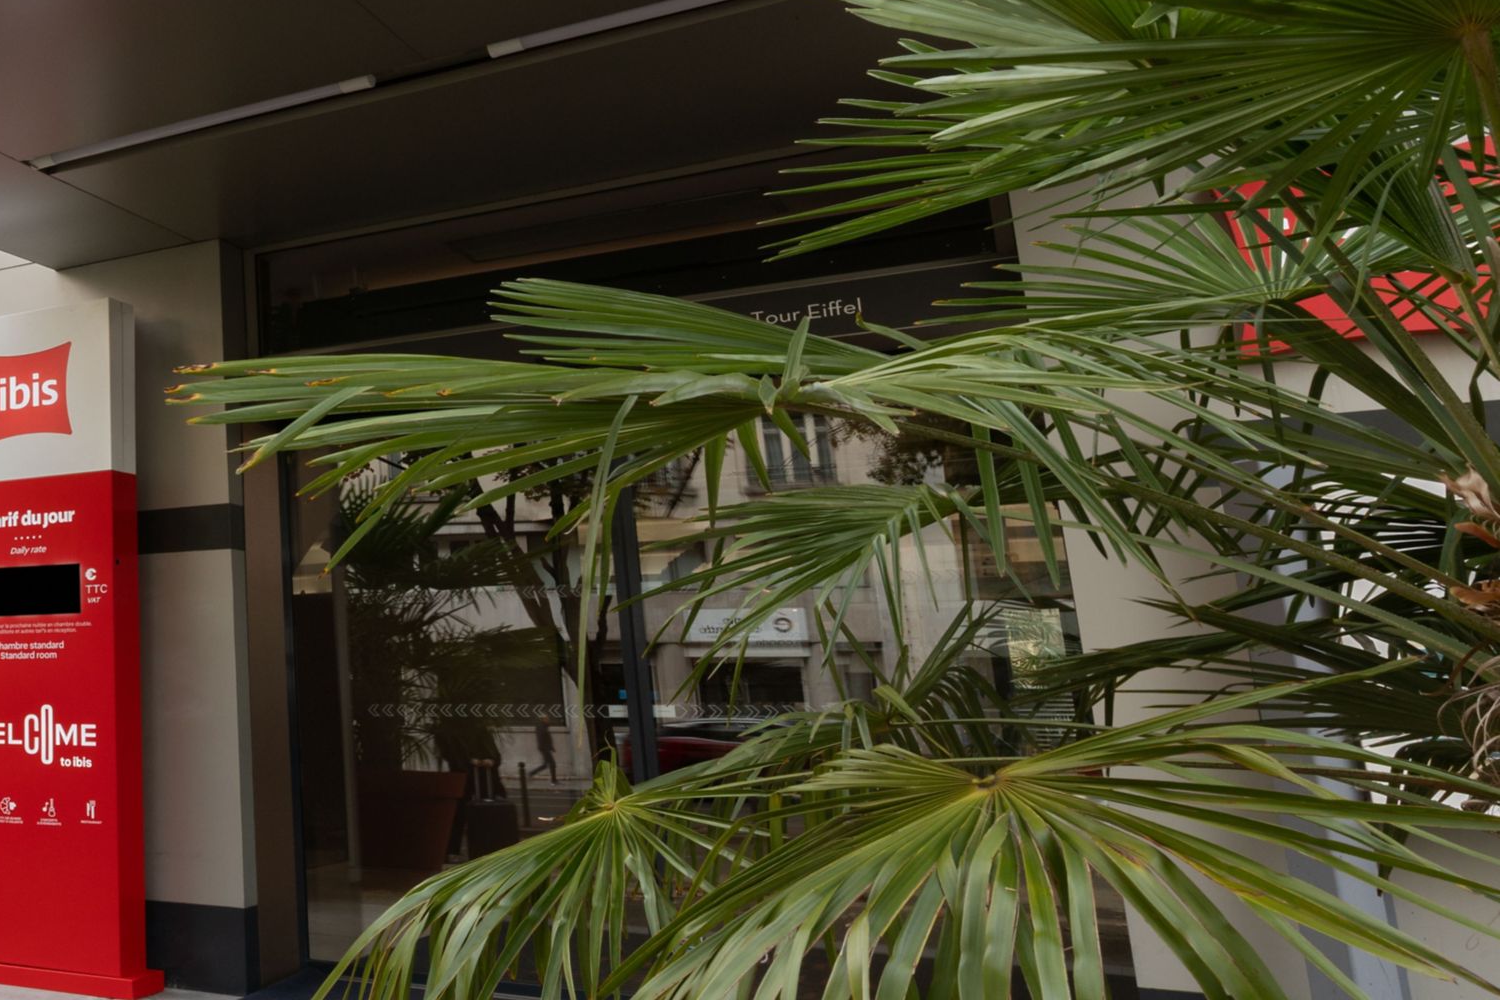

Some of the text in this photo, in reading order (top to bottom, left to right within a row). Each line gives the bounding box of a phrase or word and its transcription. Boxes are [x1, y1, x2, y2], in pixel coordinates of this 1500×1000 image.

[750, 297, 863, 325] Tour Eiffel
[0, 372, 59, 412] ibis
[21, 510, 41, 526] du
[10, 546, 47, 556] Daily rate
[85, 584, 108, 594] TTC
[29, 640, 65, 650] standard
[0, 651, 58, 660] Standard room
[60, 756, 92, 767] to ibis
